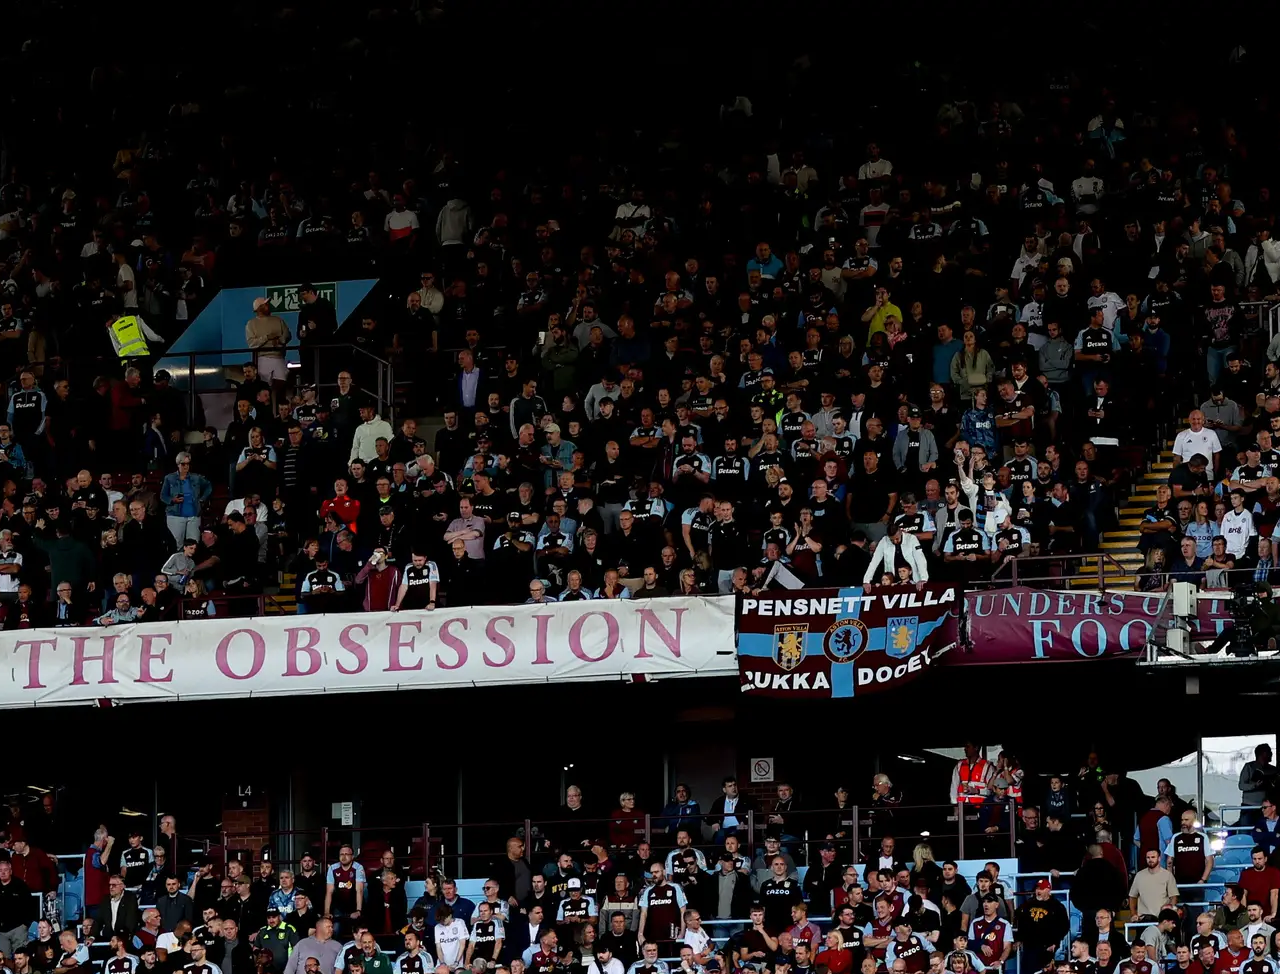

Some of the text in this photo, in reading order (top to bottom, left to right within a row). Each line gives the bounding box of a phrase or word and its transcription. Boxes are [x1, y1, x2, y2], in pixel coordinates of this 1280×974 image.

[742, 588, 955, 616] PENSNETT VILLA
[889, 617, 917, 626] AVFC
[15, 632, 175, 690] THE
[214, 604, 687, 682] OBSESSION
[238, 785, 252, 796] L4
[900, 947, 920, 957] CAZOO
